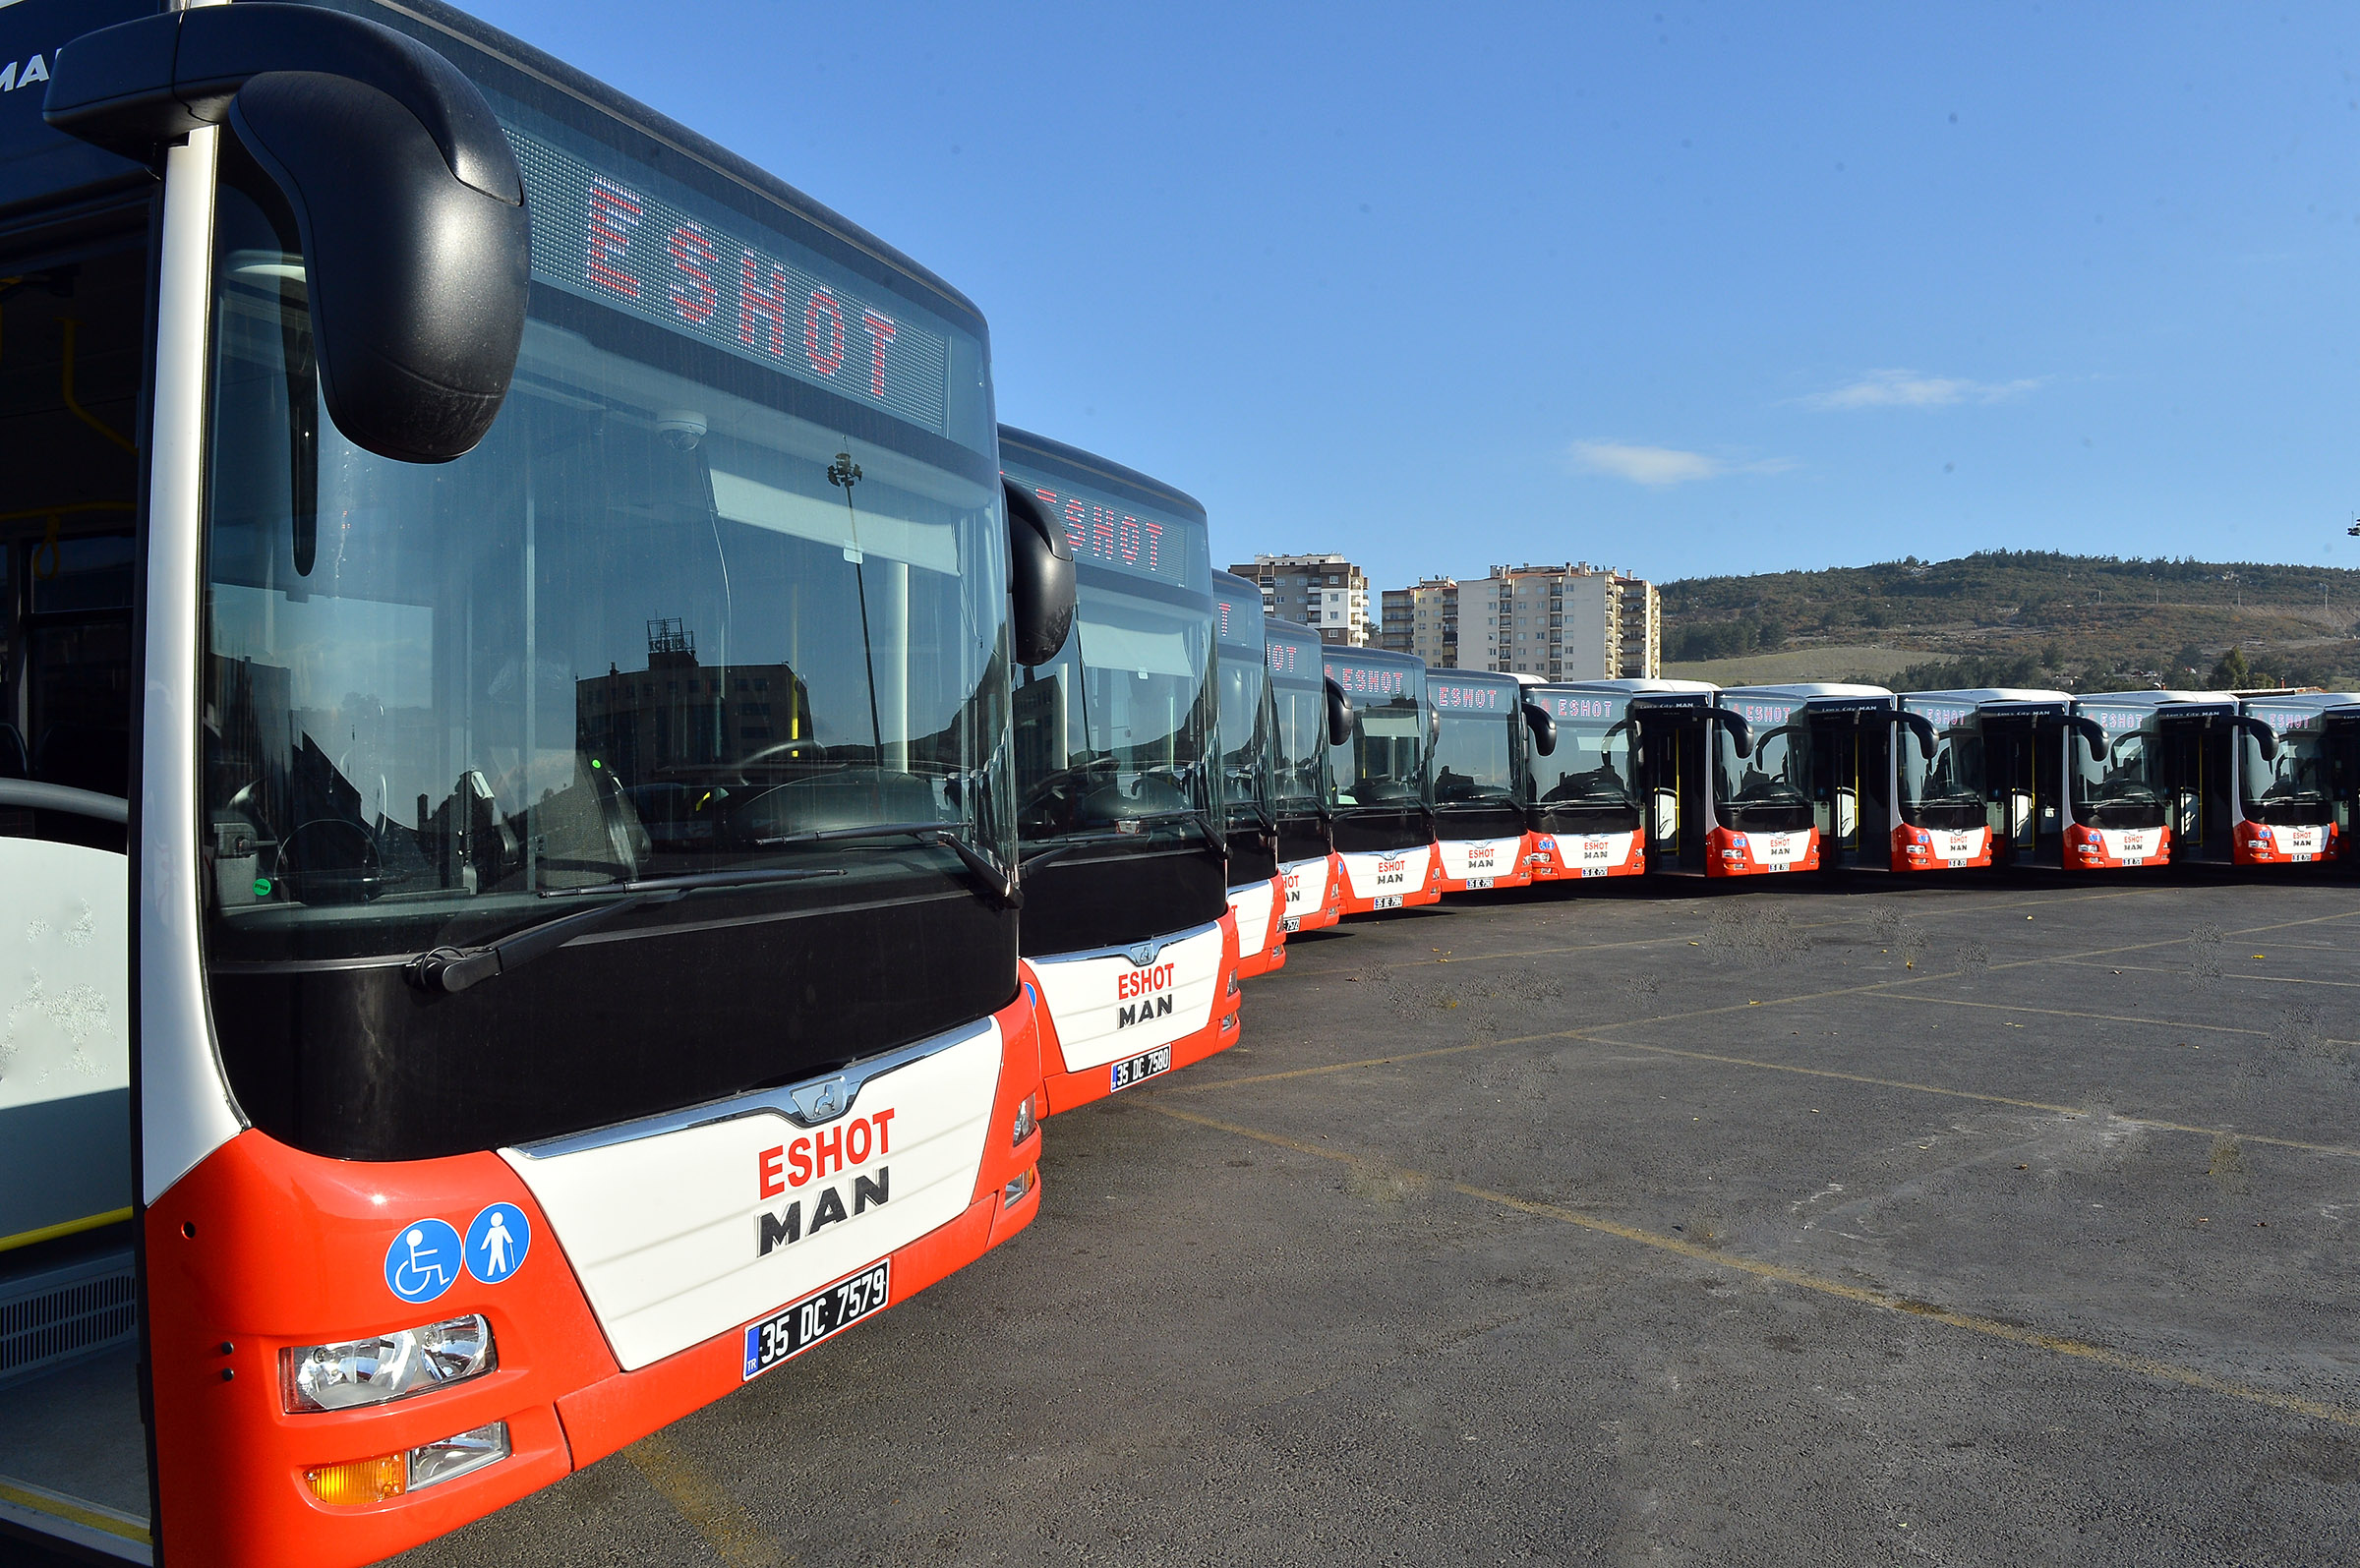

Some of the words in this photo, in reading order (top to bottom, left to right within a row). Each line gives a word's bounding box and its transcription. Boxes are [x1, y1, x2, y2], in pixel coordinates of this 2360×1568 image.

[0, 48, 62, 91] MA
[587, 175, 896, 399] ESHOT
[1342, 668, 1403, 694] ESHOT
[1439, 687, 1497, 709] ESHOT
[1558, 699, 1612, 718] ESHOT
[1746, 705, 1791, 723] ESHOT
[1927, 709, 1966, 726] ESHOT
[2099, 713, 2143, 728] ESHOT
[2270, 714, 2310, 729] ESHOT
[1584, 842, 1609, 850] ESHOT
[1770, 839, 1791, 847] ESHOT
[1468, 848, 1495, 859] ESHOT
[1378, 860, 1405, 873] ESHOT
[1468, 859, 1494, 868] MAN
[1377, 873, 1403, 885] MAN
[1118, 962, 1174, 1000] ESHOT
[1117, 994, 1172, 1029] MAN
[1117, 1063, 1129, 1086] 35
[1132, 1057, 1144, 1080] DC
[1147, 1048, 1168, 1074] 7580
[759, 1108, 895, 1200] ESHOT
[756, 1166, 889, 1258] MAN
[760, 1314, 790, 1365] 35
[799, 1297, 828, 1346] DC
[836, 1267, 886, 1326] 7579
